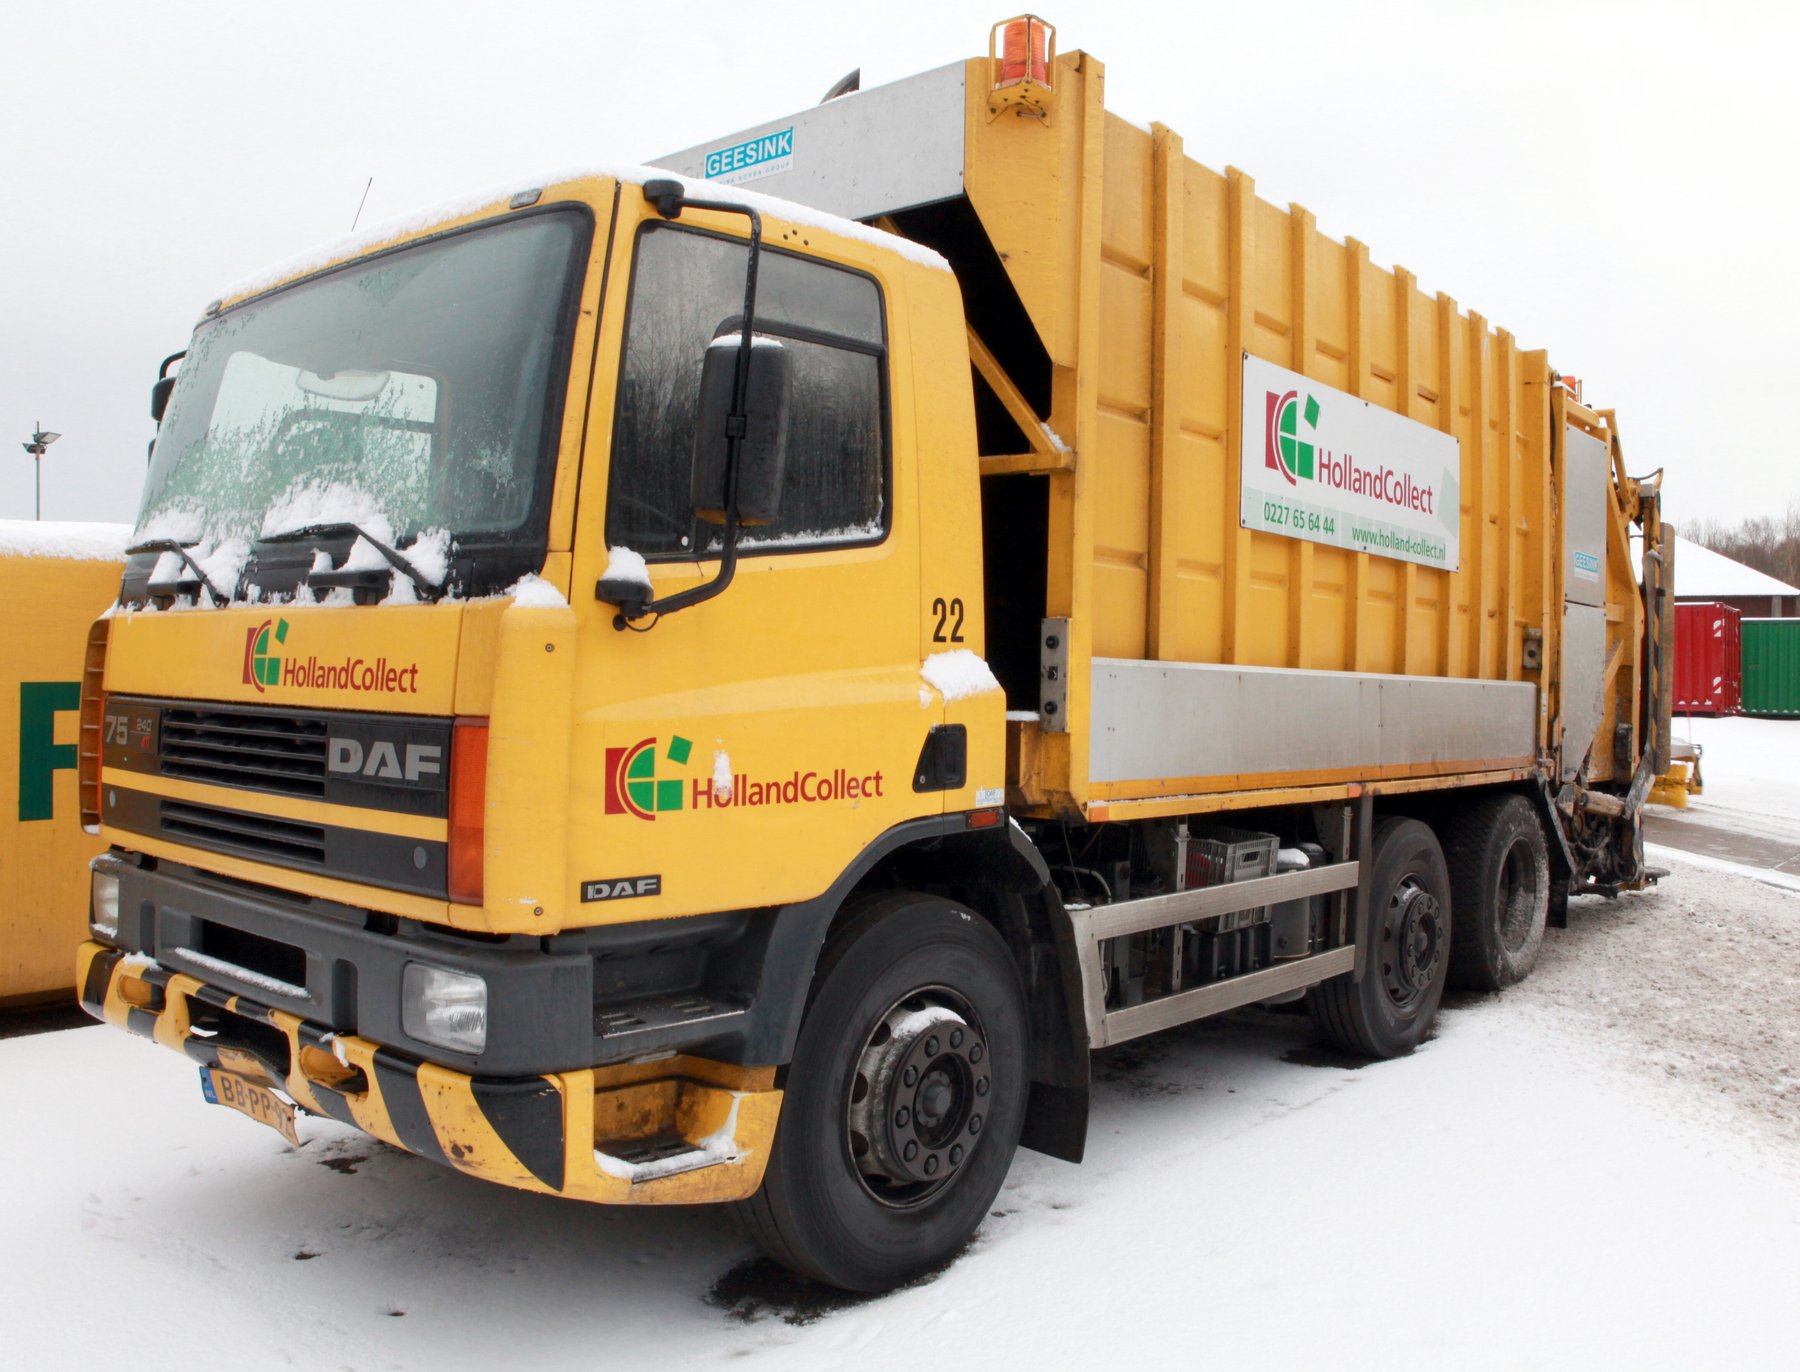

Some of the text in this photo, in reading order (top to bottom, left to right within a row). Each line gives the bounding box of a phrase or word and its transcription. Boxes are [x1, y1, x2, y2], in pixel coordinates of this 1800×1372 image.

[707, 132, 791, 175] GEESINK
[765, 161, 790, 173] GROUP
[1318, 447, 1433, 515] HollandCollect
[1264, 502, 1335, 535] 0227 65 64 44
[1352, 527, 1446, 561] www.holland-collect.nl
[932, 597, 964, 643] 22
[283, 656, 418, 693] HollandCollect
[105, 715, 129, 745] 75
[328, 737, 441, 781] DAF
[692, 768, 883, 809] HollandCollect
[587, 878, 657, 900] DAF
